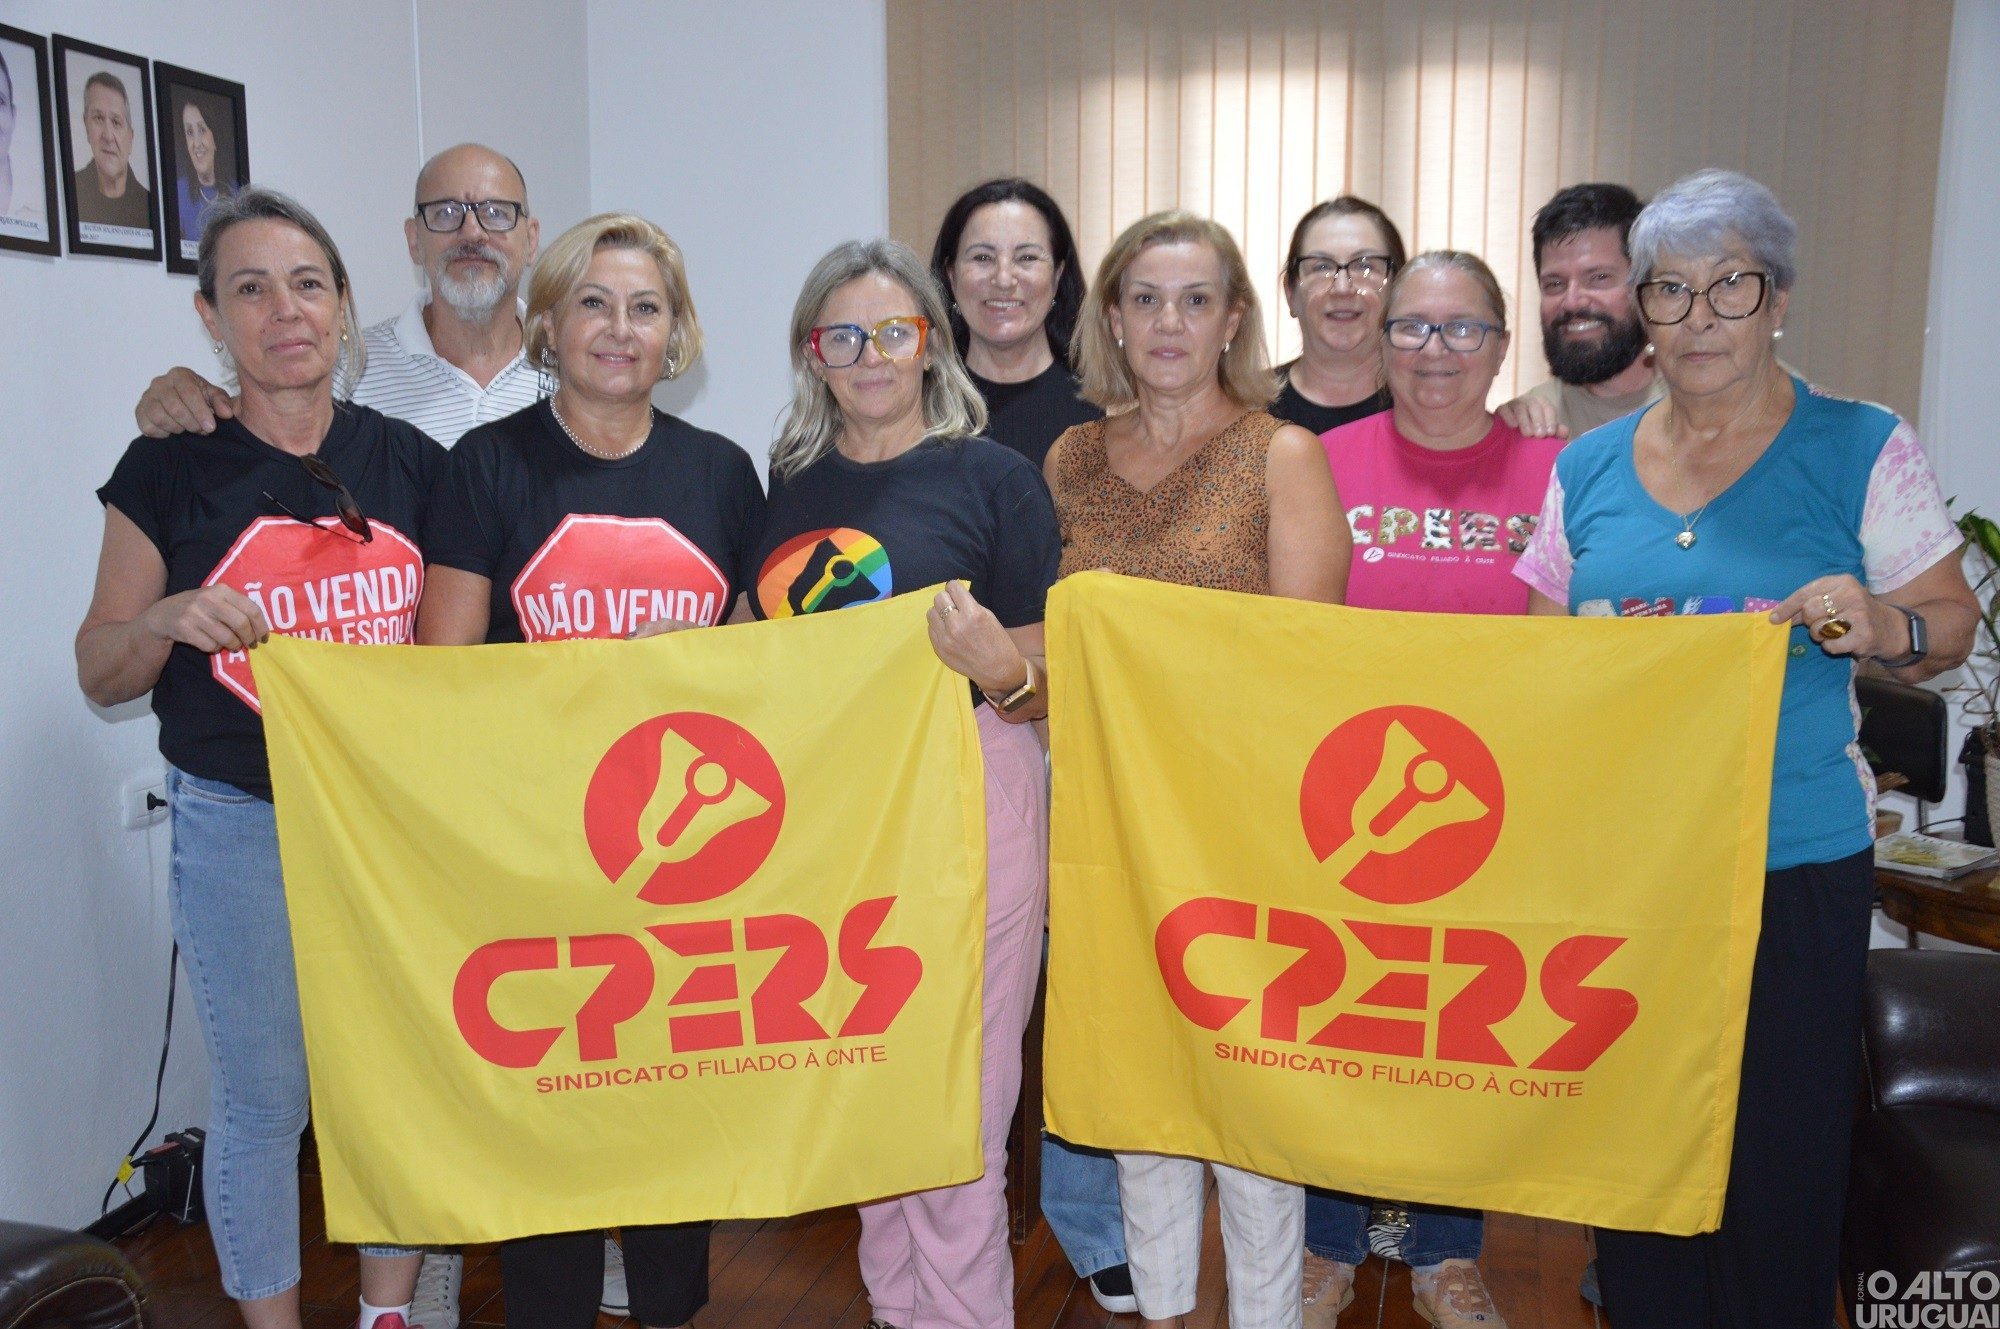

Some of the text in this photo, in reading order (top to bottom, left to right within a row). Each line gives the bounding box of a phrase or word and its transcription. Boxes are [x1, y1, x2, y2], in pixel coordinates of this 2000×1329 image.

[1346, 504, 1540, 554] CPERS
[1387, 551, 1427, 561] SINDICATO
[1430, 555, 1460, 563] FILIADO
[244, 563, 417, 631] ÃO VENDA
[525, 582, 715, 636] NÃO VENDA
[453, 896, 923, 1069] CPERS
[1155, 897, 1639, 1071] CPERS
[536, 1045, 888, 1094] SINDICATO FILIADO À CNTE
[1214, 1042, 1584, 1098] SINDICATO FILIADO À CNTE
